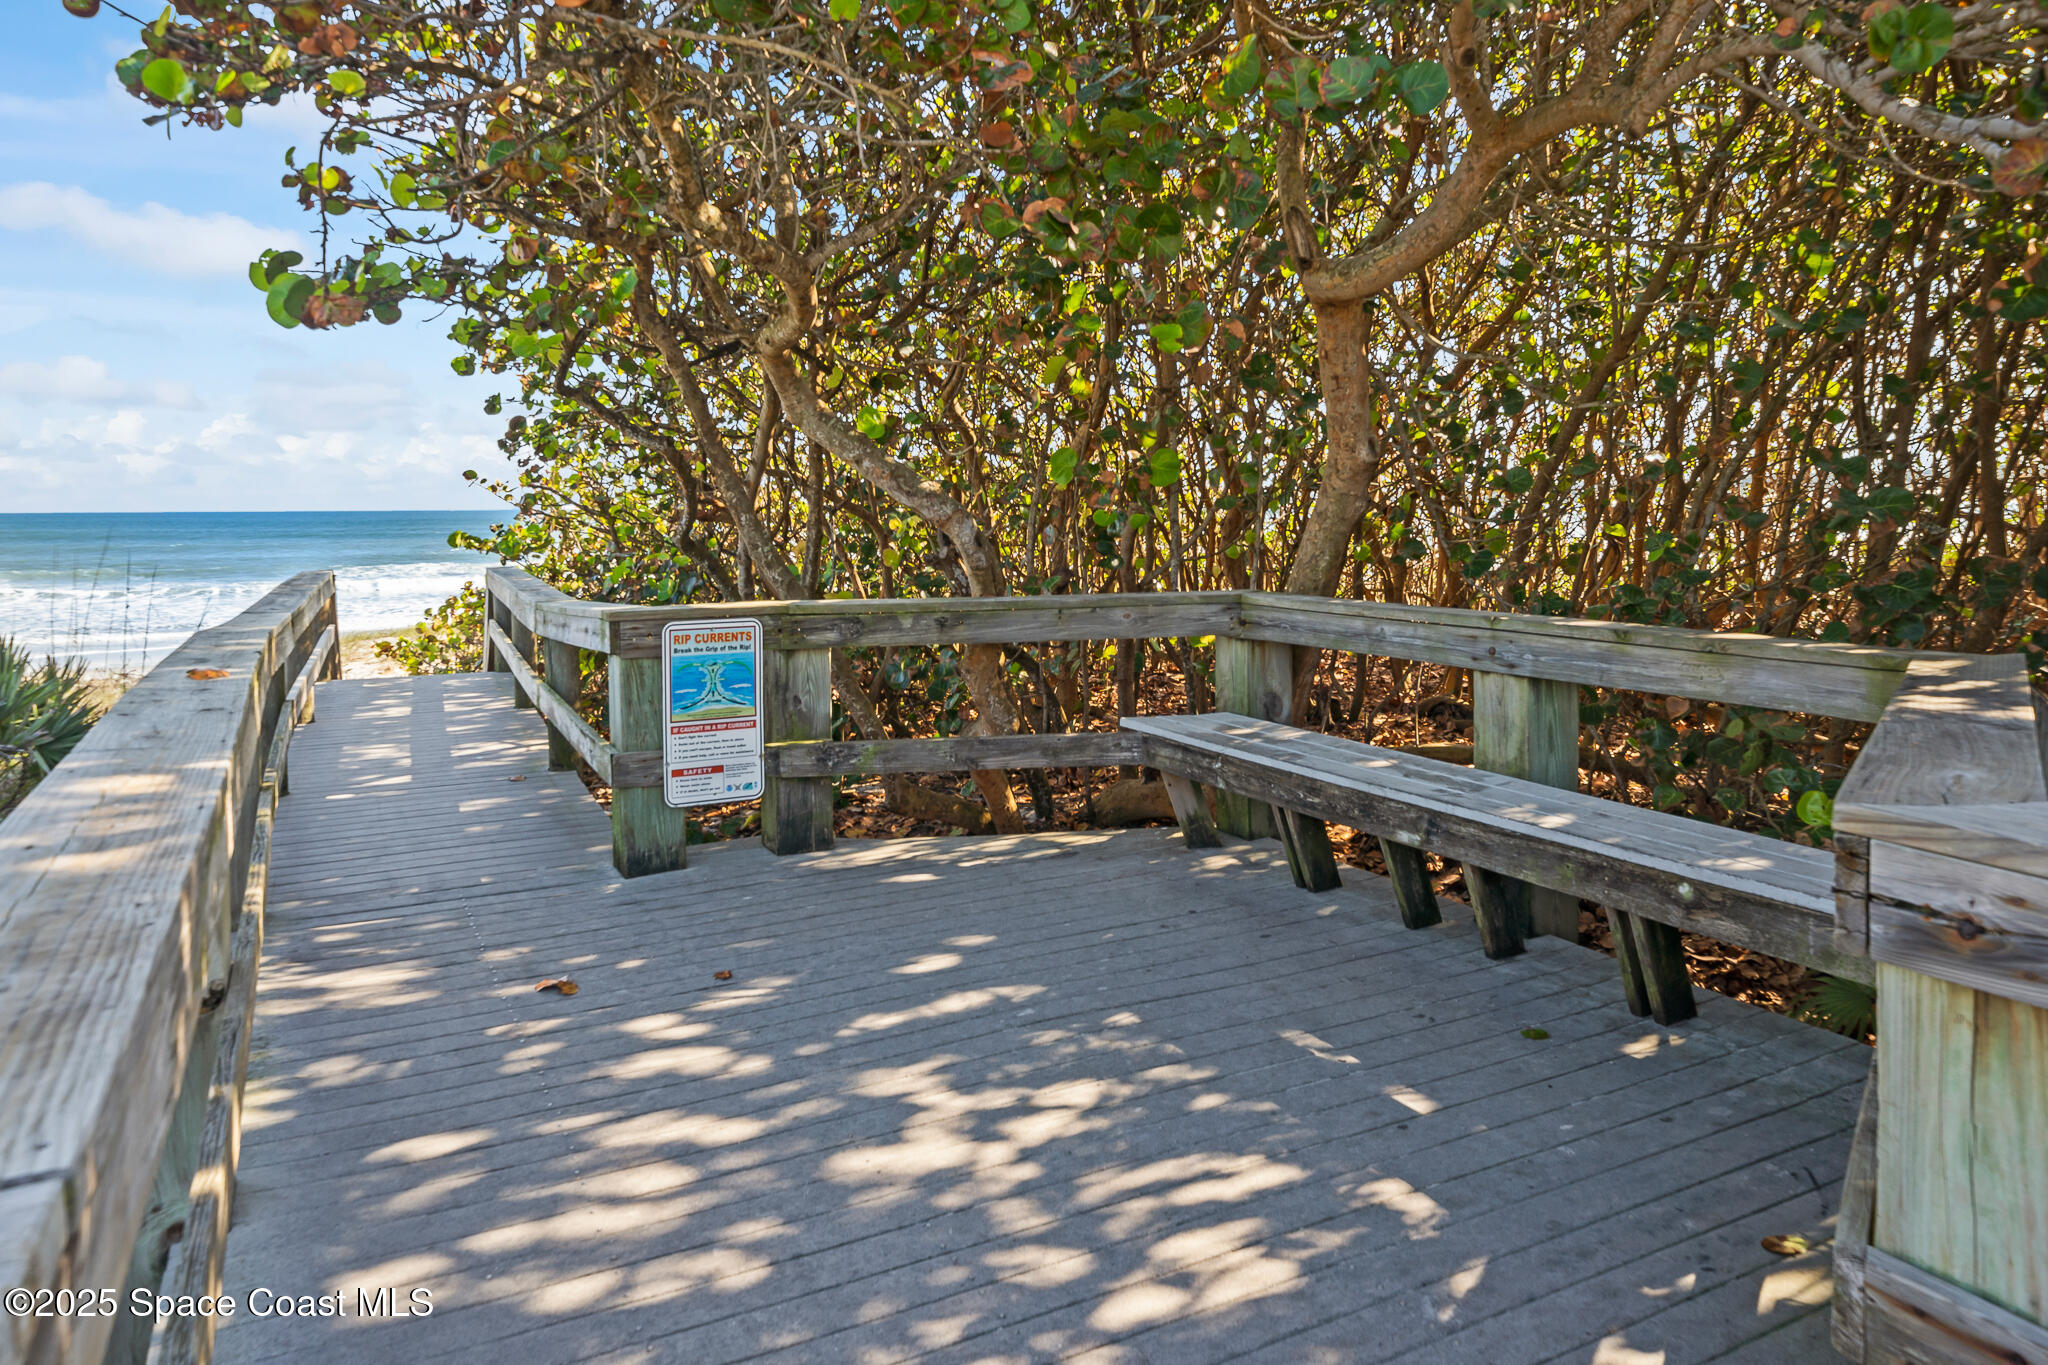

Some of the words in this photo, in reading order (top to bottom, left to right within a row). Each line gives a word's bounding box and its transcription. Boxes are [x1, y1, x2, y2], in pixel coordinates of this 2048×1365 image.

[673, 634, 691, 645] RIP
[694, 631, 753, 644] CURRENTS
[705, 645, 719, 653] Grip
[680, 725, 704, 733] CAUGHT
[727, 721, 754, 729] CURRENT
[683, 767, 713, 775] SAFETY
